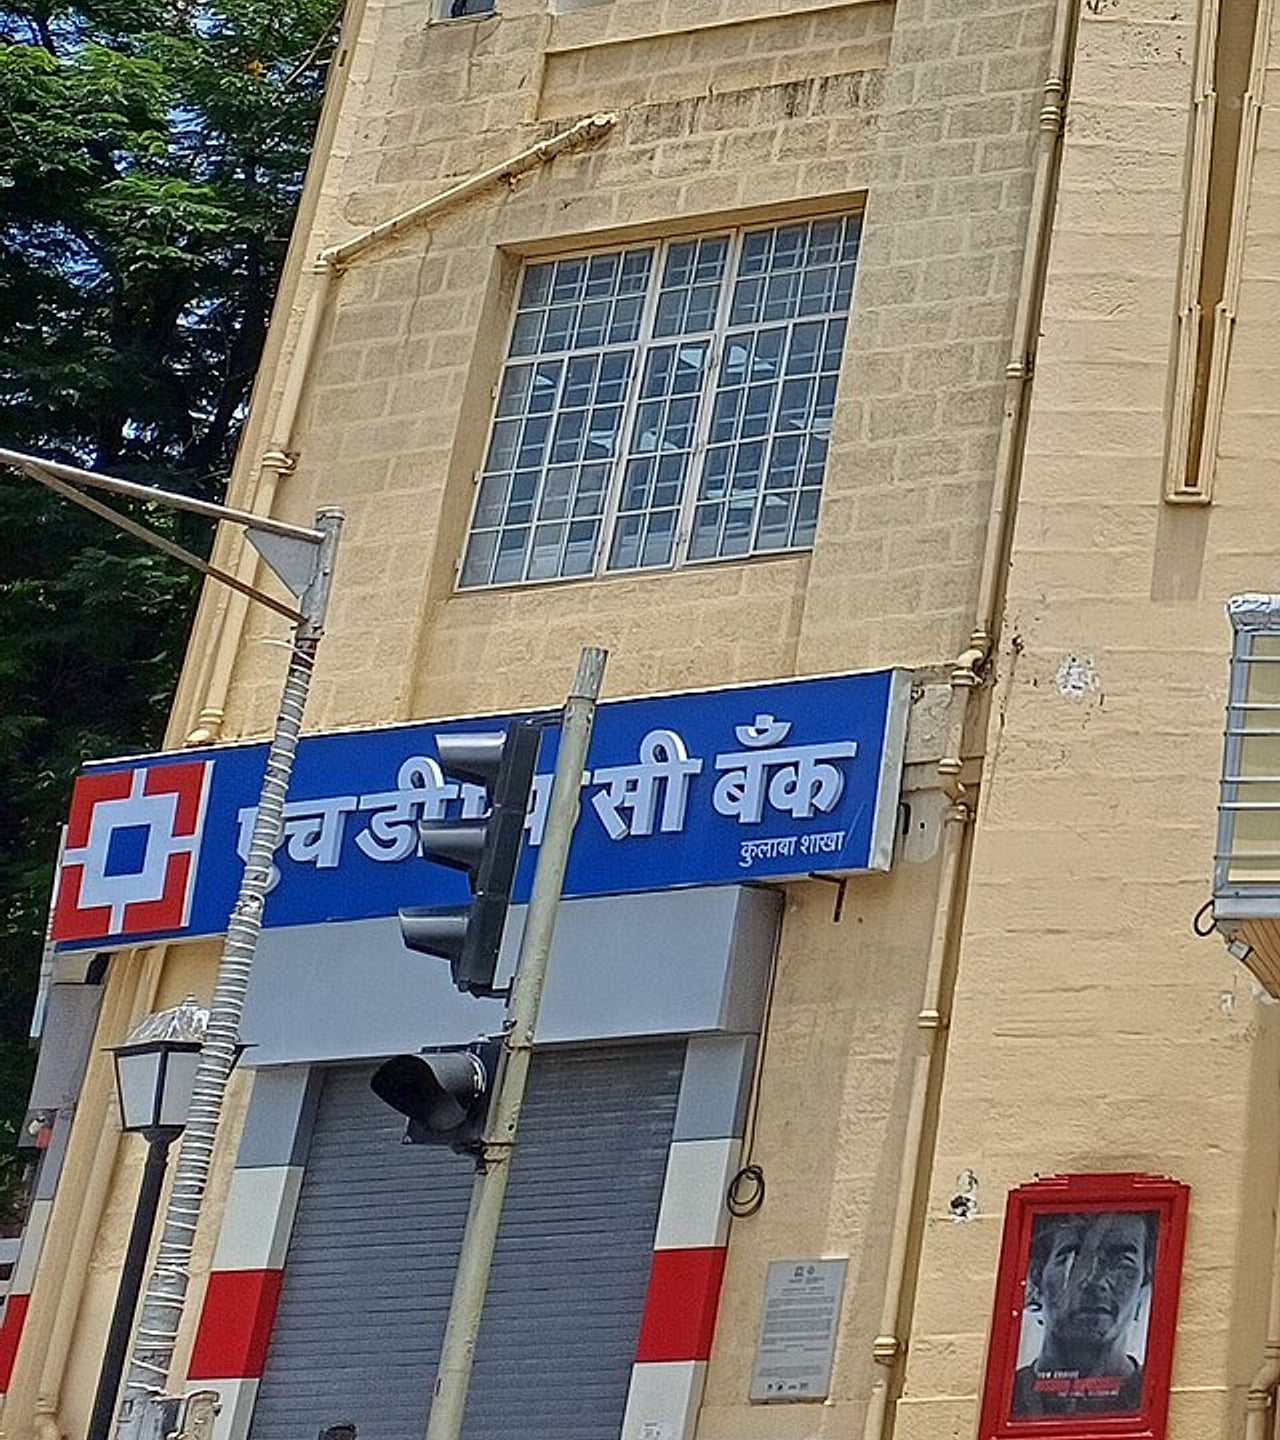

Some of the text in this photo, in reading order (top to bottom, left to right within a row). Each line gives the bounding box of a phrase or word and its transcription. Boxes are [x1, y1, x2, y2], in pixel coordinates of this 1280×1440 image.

[713, 713, 858, 824] बँक
[739, 830, 846, 868] कुलाबा शाखा
